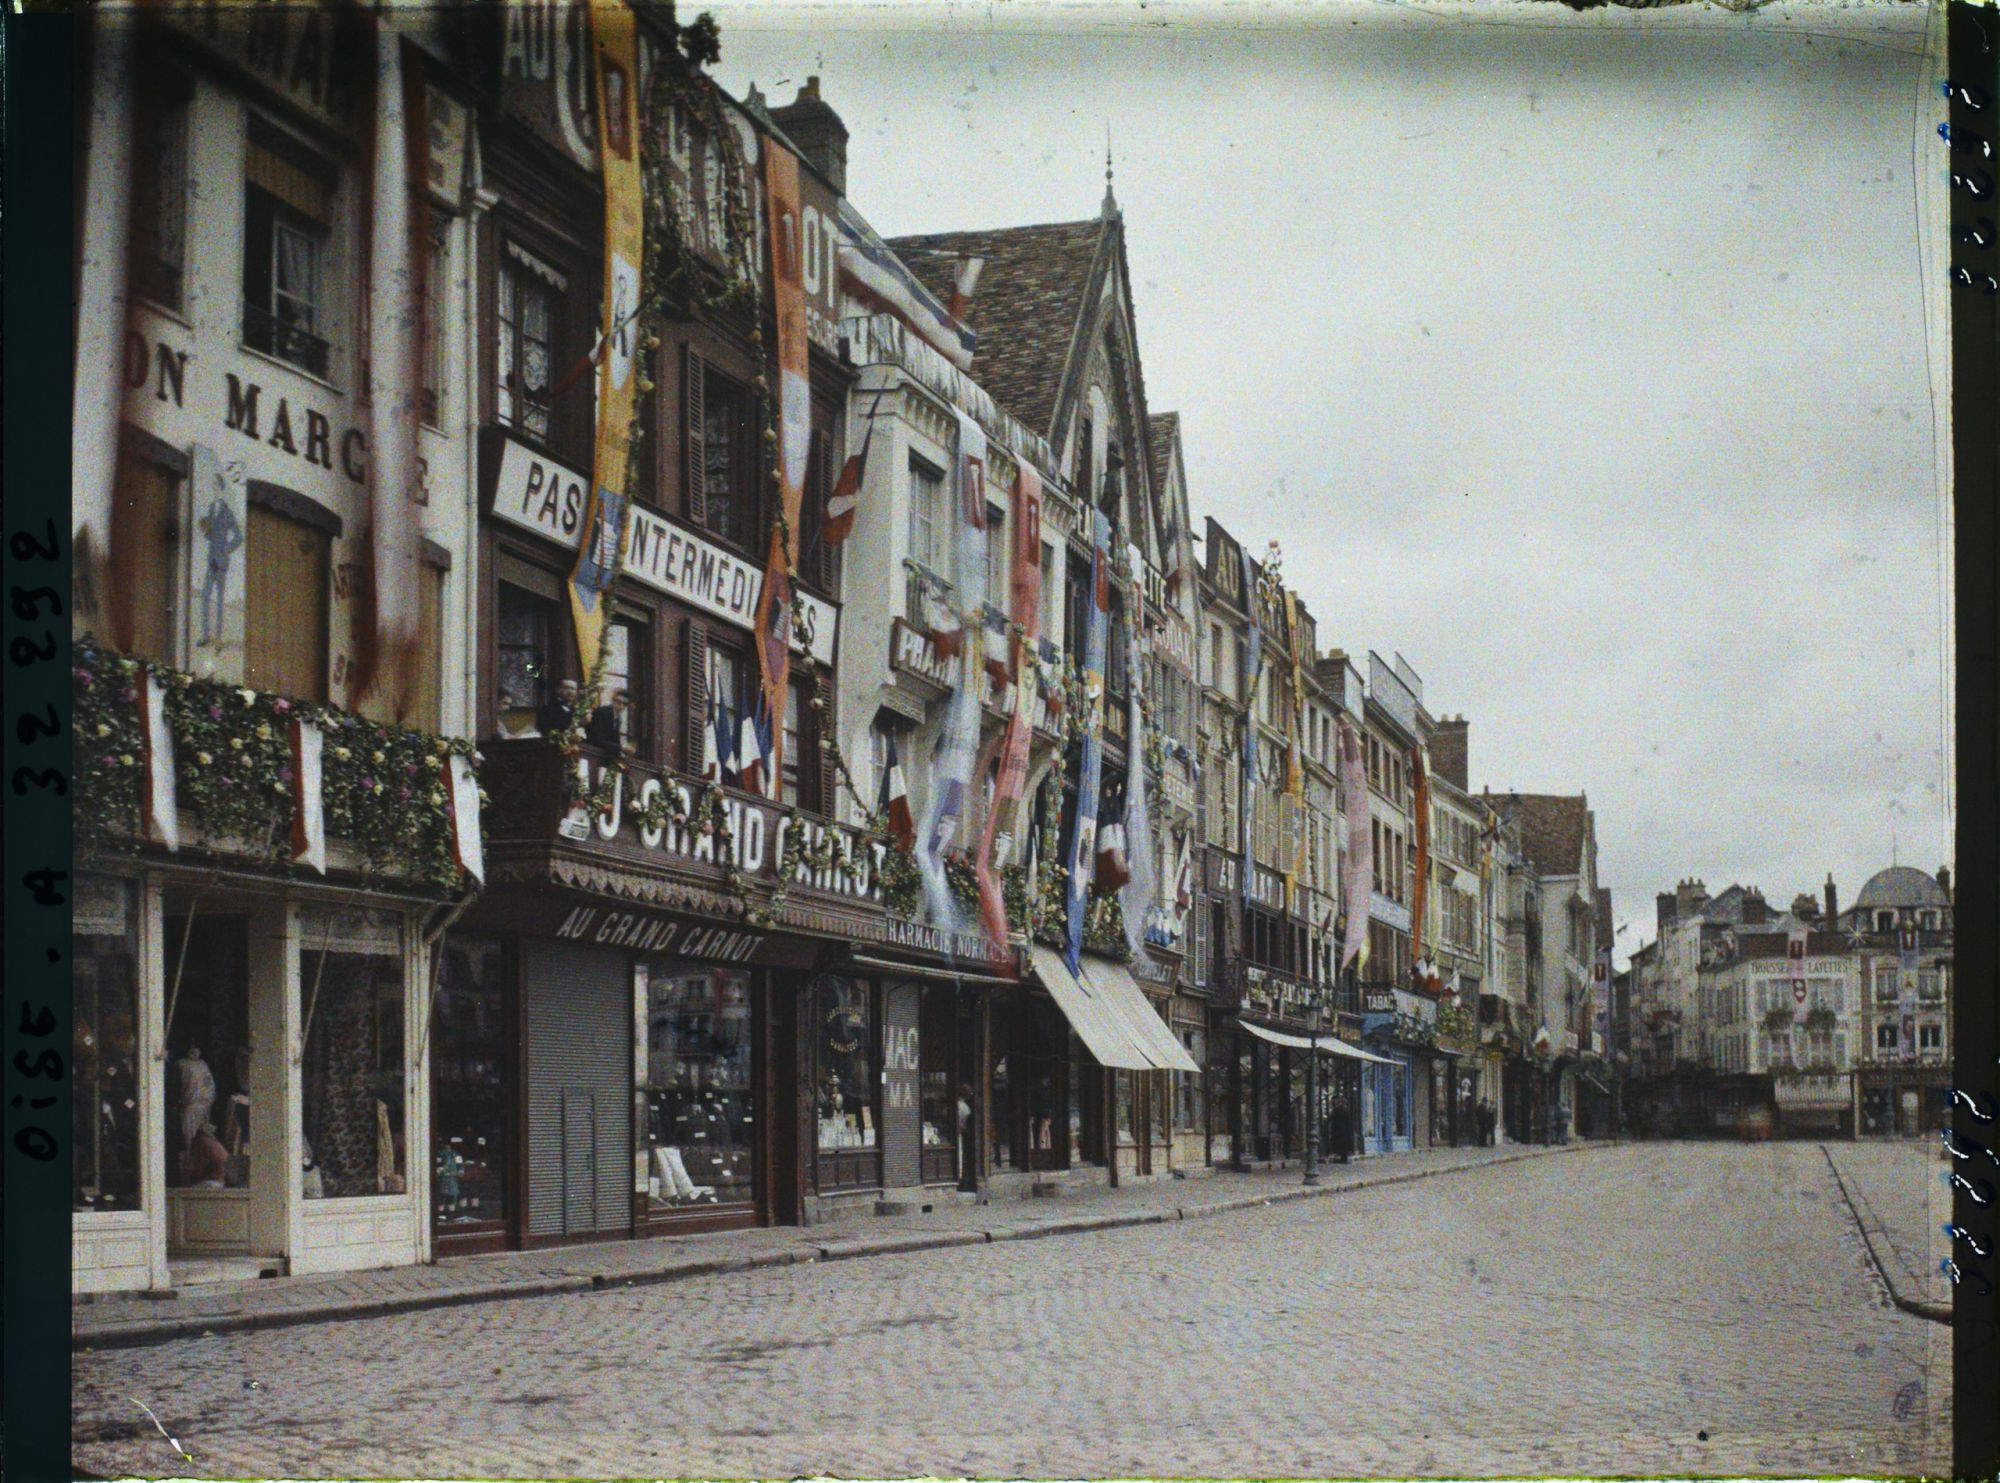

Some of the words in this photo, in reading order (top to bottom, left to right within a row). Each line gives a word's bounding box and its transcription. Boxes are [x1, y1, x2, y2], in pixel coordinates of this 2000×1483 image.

[522, 461, 581, 535] PAS
[557, 906, 596, 939] AU
[599, 911, 678, 951] GRAND
[678, 926, 764, 963] CARNOT
